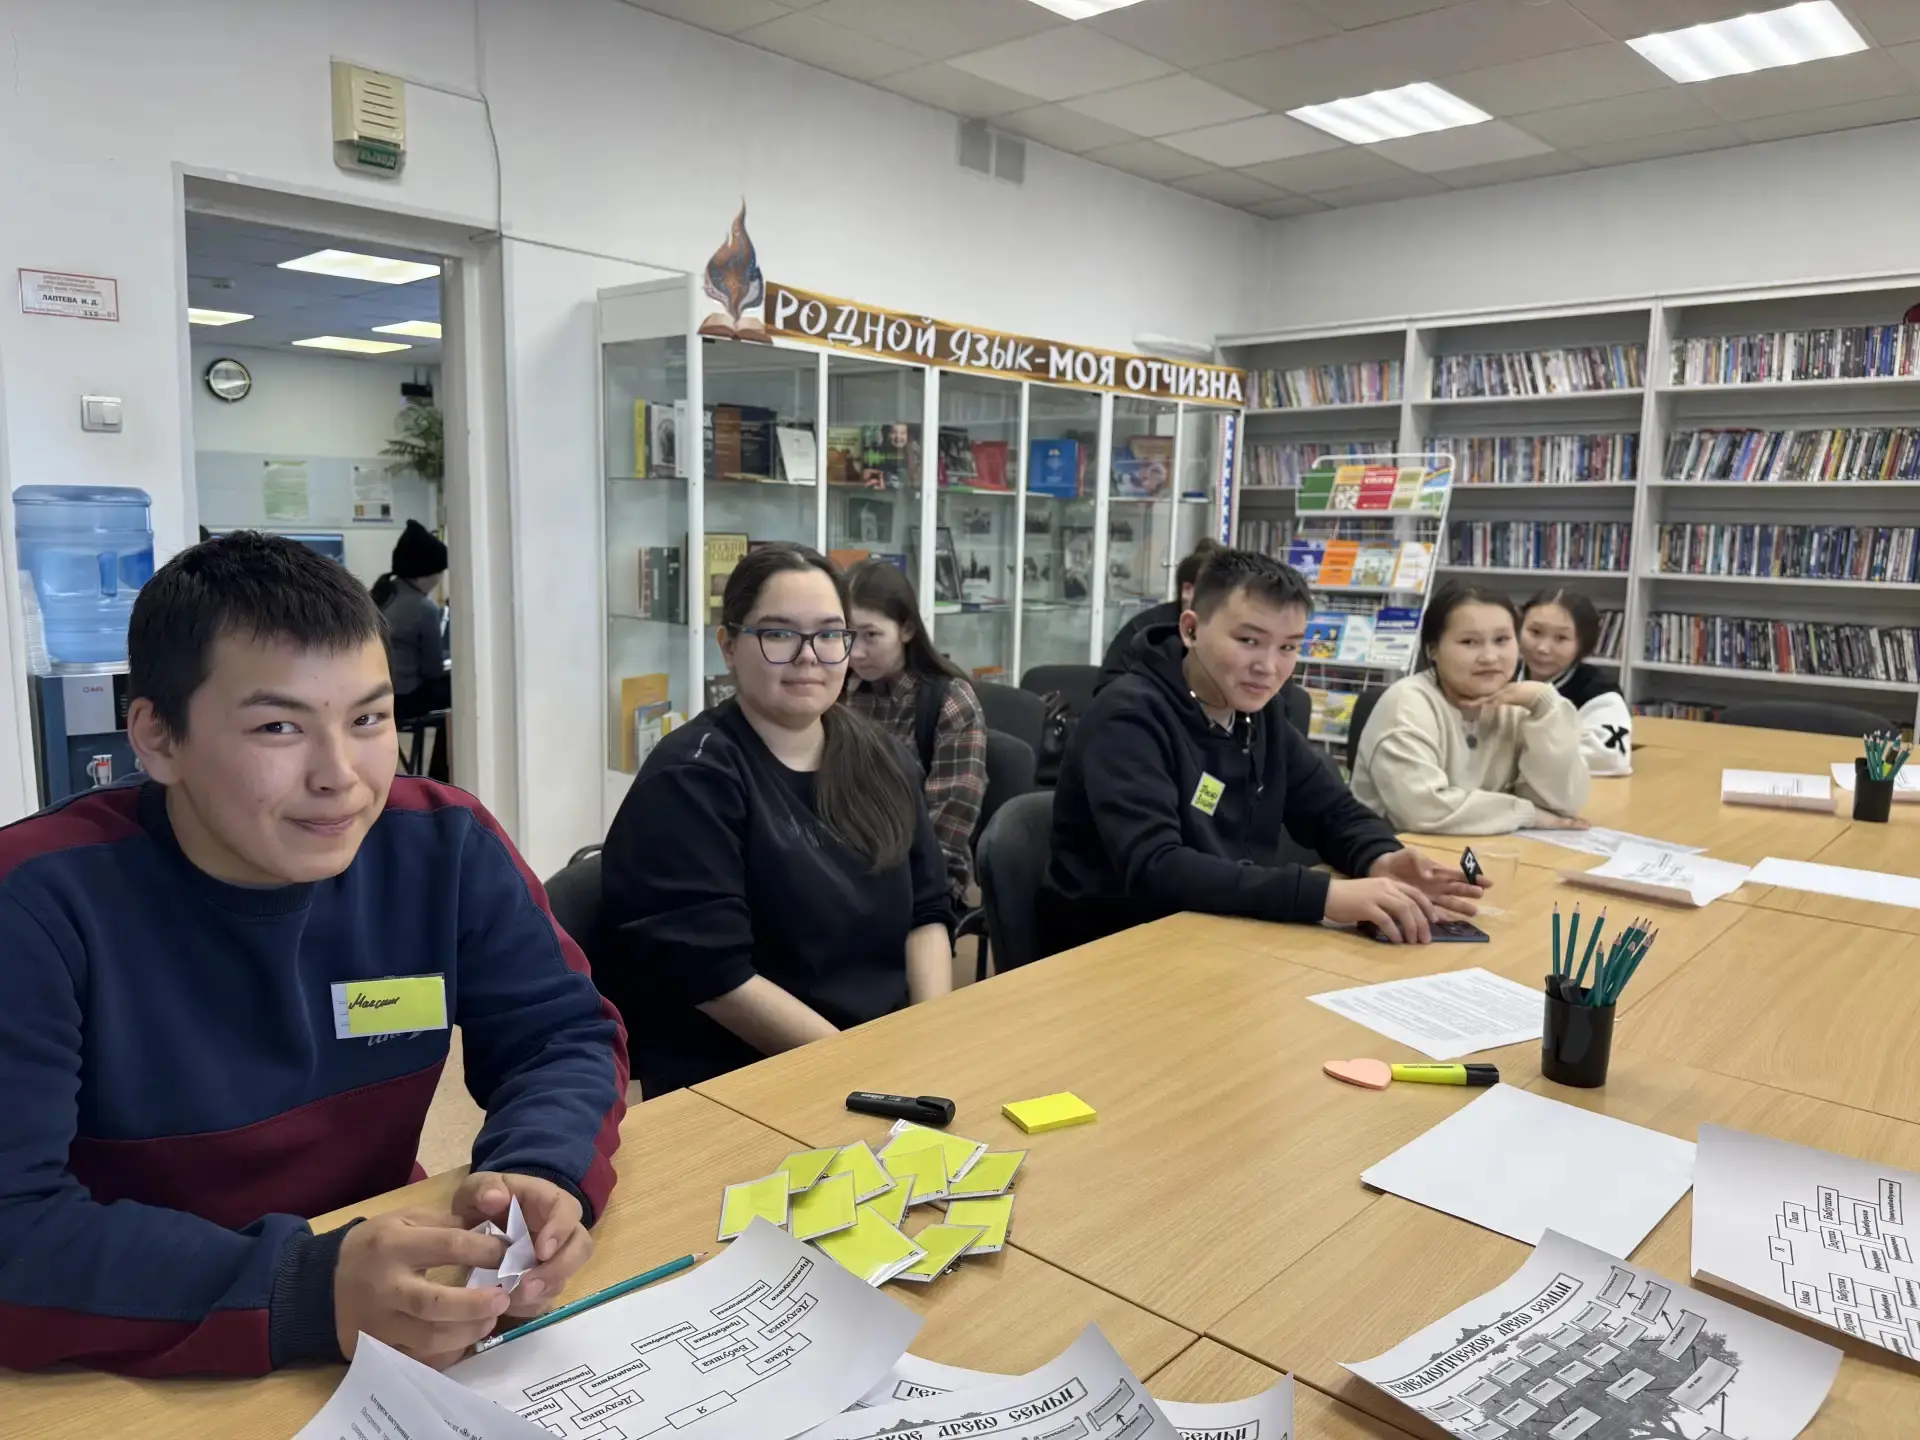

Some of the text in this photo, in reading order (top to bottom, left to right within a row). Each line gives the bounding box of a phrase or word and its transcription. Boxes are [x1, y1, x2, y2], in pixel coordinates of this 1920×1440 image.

[42, 294, 78, 304] ЛАПТЕВА
[775, 289, 936, 359] РОДНОЙ
[1125, 359, 1243, 401] ОТЧИЗНА
[1823, 1192, 1834, 1221] Бабушка
[771, 1260, 809, 1301] Прадедушка
[716, 1284, 766, 1316] Прапрадедушка
[1494, 1311, 1534, 1337] ДРЕВО
[1529, 1281, 1573, 1315] СЕМЬИ
[767, 1299, 810, 1335] Дедушка
[638, 1325, 692, 1349] Прапрабабушка
[693, 1320, 741, 1344] Прабабушка
[701, 1344, 750, 1367] Бабушка
[764, 1345, 796, 1365] Мама
[531, 1370, 591, 1397] Прапрадедушка
[591, 1362, 644, 1388] Прадедушка
[580, 1396, 633, 1422] Дедушка
[696, 1405, 708, 1415] Я
[938, 1416, 999, 1439] ДРЕВО
[1008, 1387, 1075, 1423] СЕМЬИ
